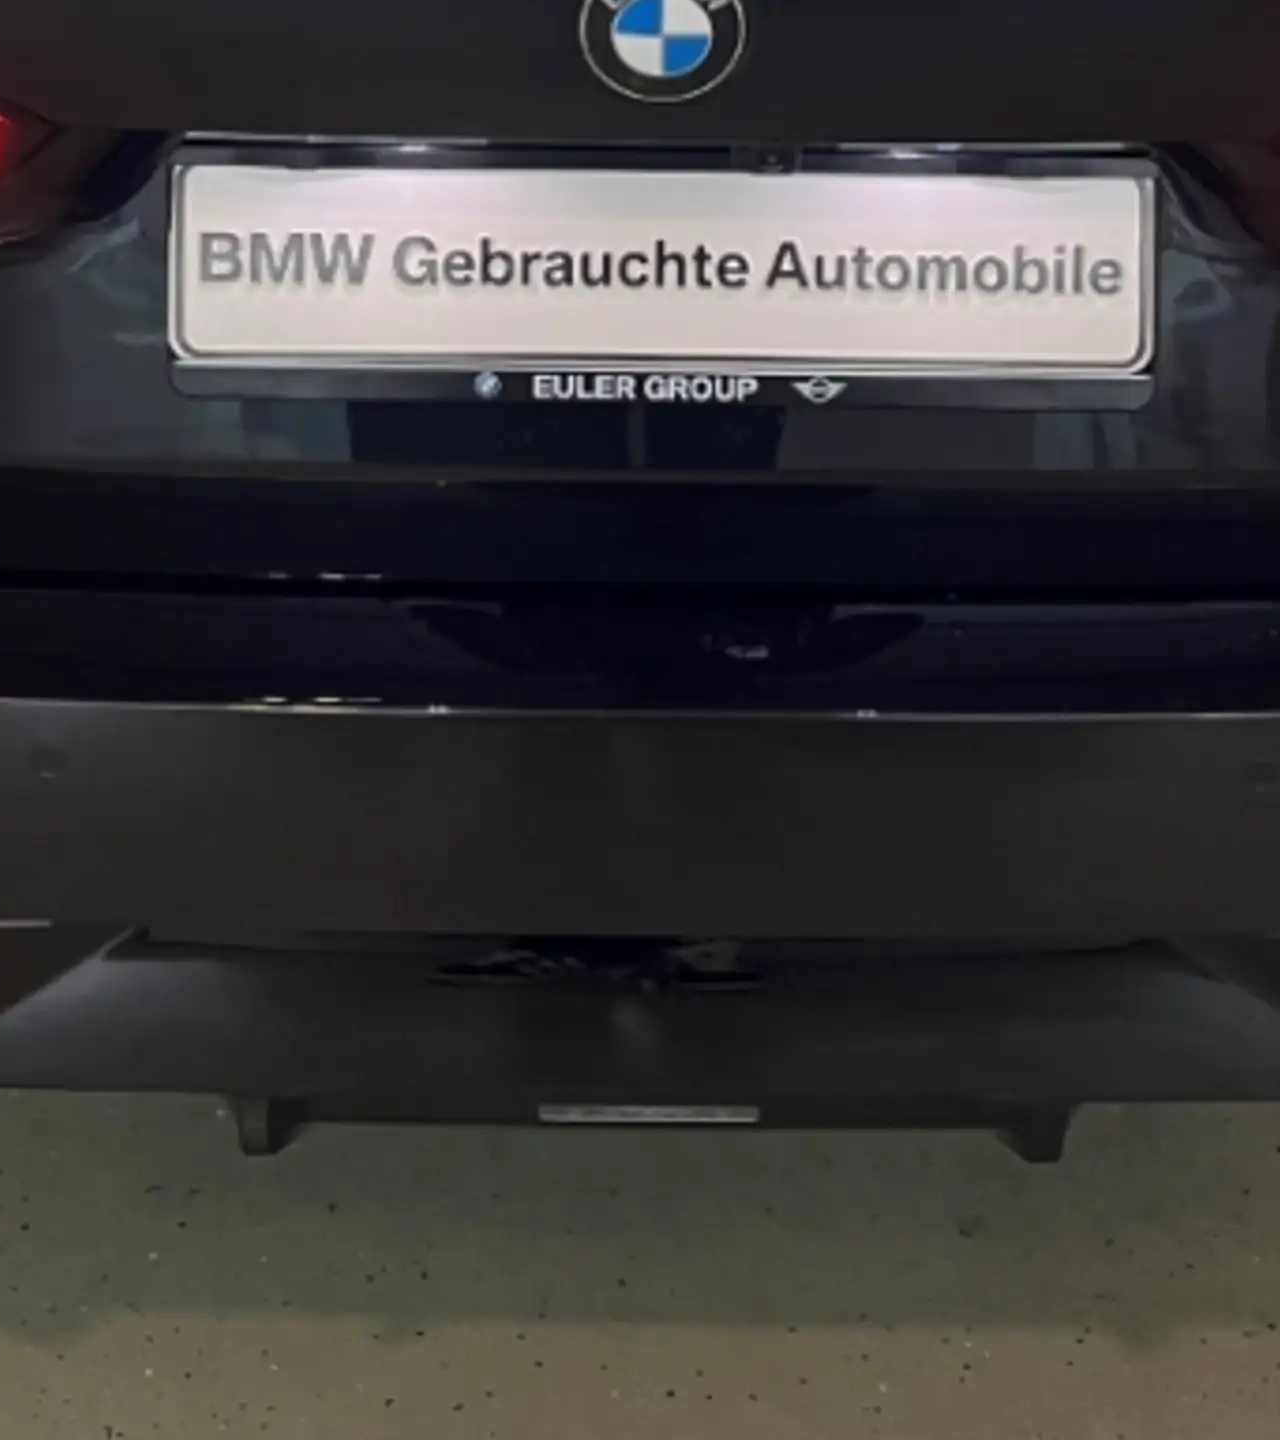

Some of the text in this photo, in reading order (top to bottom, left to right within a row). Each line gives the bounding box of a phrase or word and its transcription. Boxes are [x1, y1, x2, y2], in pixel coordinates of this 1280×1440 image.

[198, 232, 1123, 296] BMW Gebrauchte Automobile
[531, 374, 759, 402] EULER GROUP
